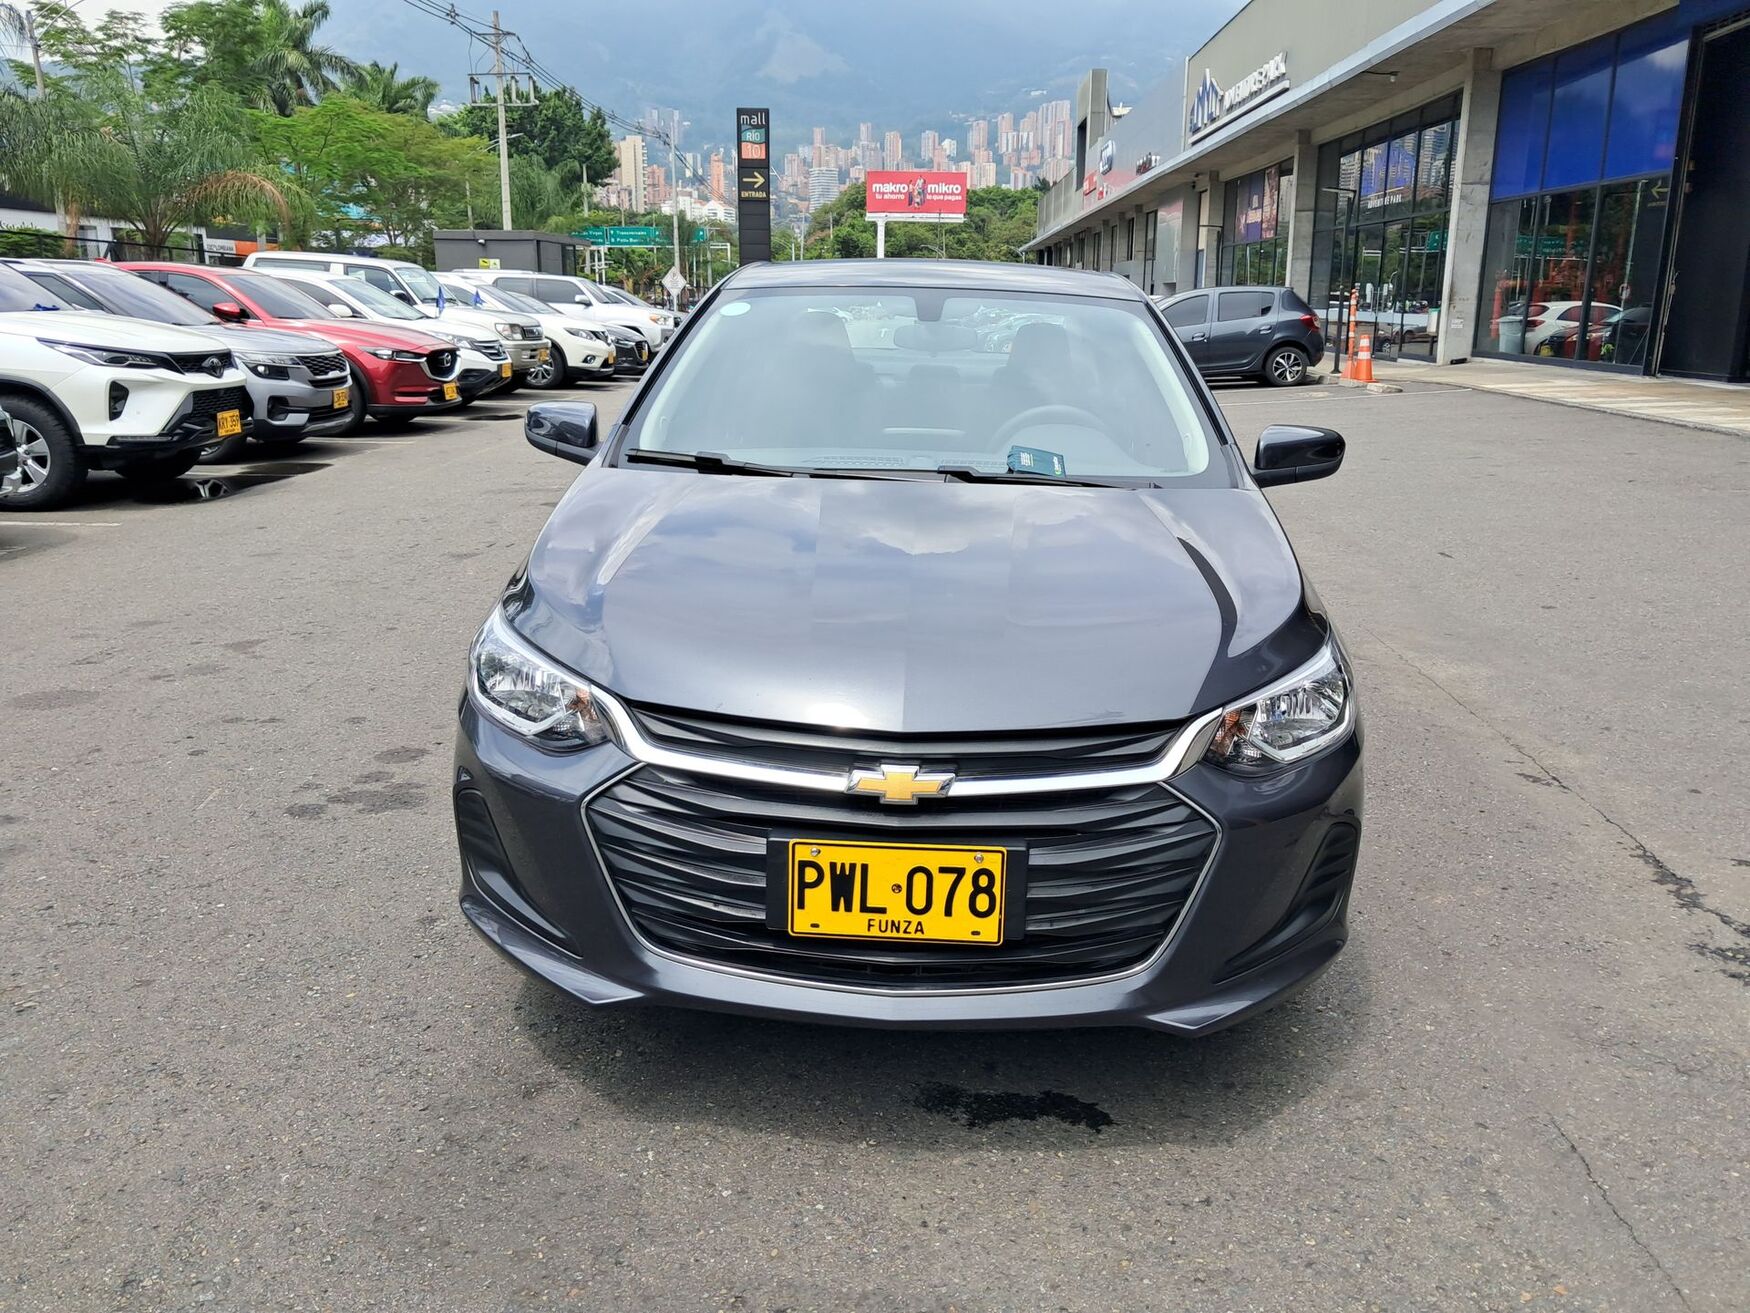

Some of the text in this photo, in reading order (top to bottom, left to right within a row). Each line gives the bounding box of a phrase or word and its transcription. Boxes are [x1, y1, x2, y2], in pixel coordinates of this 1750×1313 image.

[740, 112, 766, 125] mall
[746, 145, 761, 158] 10
[872, 182, 962, 194] makro mikro
[944, 194, 962, 202] pagas
[797, 860, 997, 918] PWL 078
[867, 918, 925, 935] FUNZA
